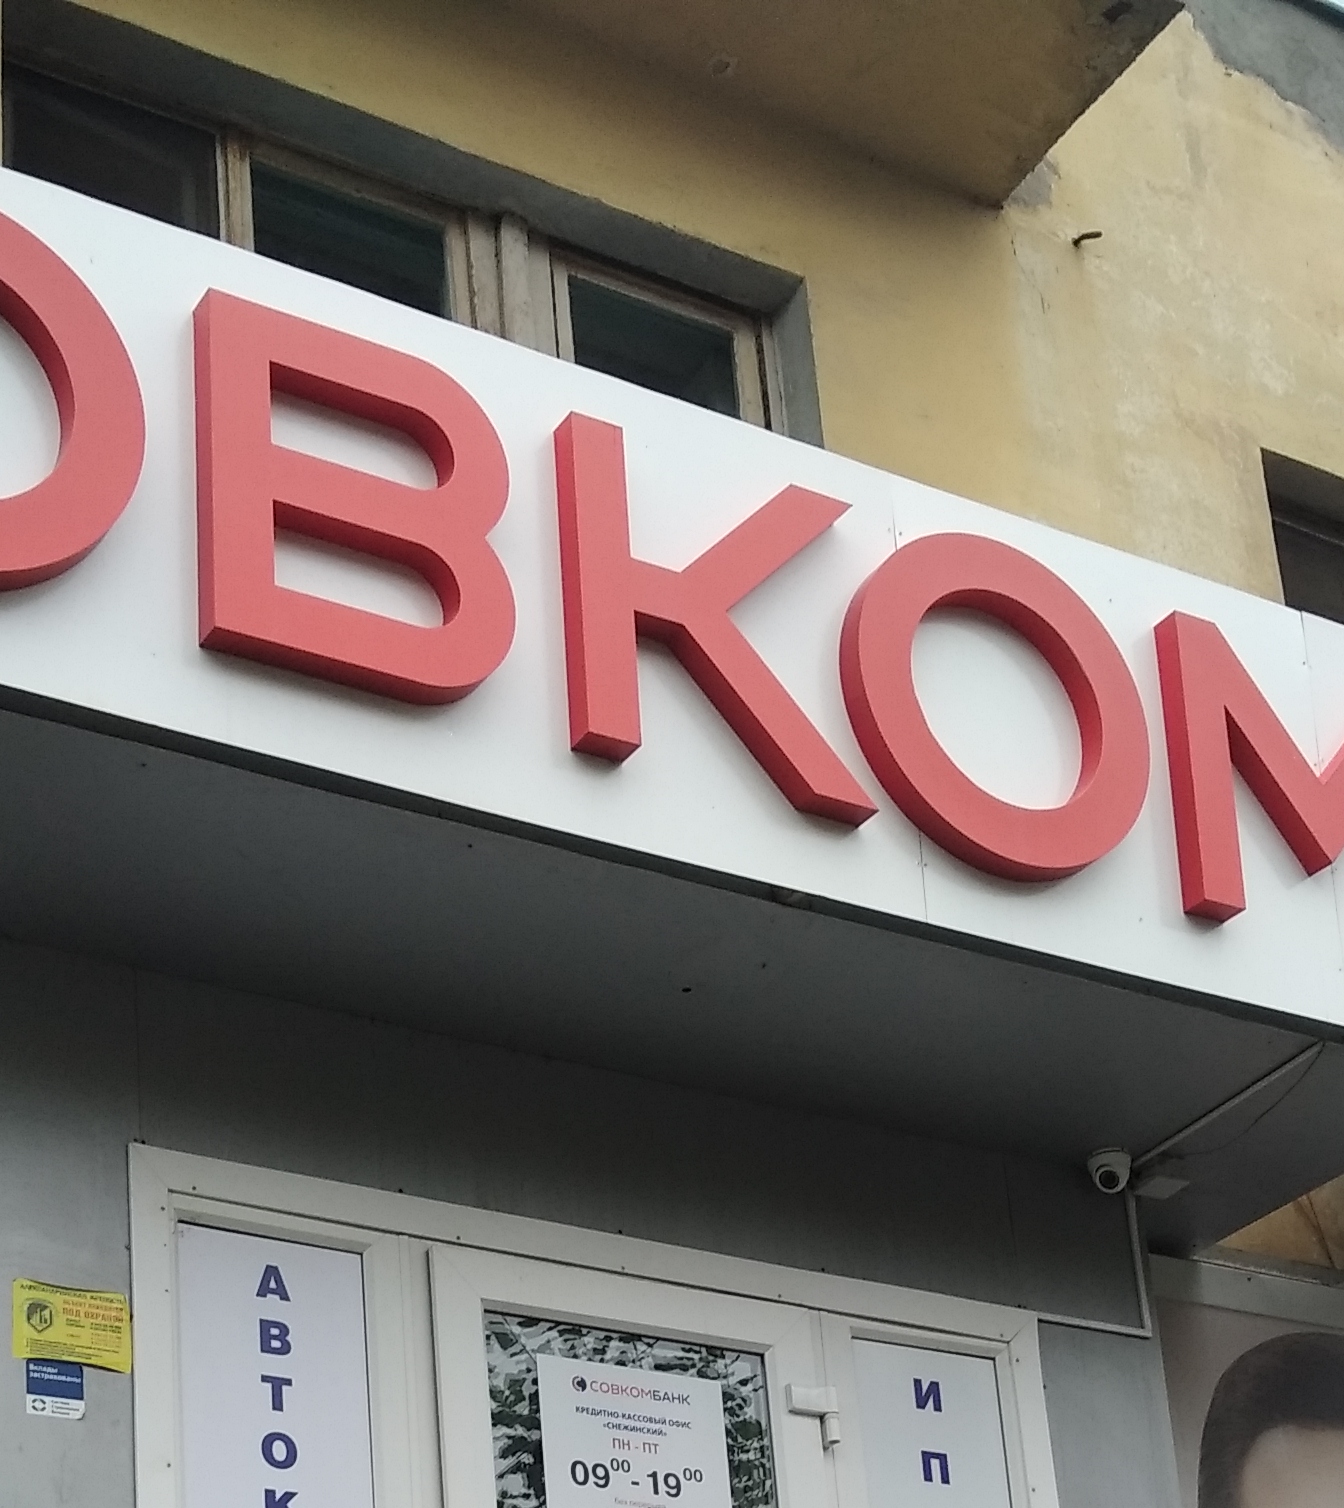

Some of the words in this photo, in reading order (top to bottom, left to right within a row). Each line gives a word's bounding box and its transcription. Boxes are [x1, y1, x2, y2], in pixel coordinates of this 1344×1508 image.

[589, 1380, 691, 1406] СОВКОМБАНК
[575, 1405, 667, 1427] КРЕДИТНО-КАССОВЫЙ
[668, 1418, 693, 1430] ОФИС
[603, 1421, 668, 1438] «СНЕЖИНСКИЙ»
[612, 1437, 632, 1451] ПН
[642, 1441, 660, 1455] ПТ
